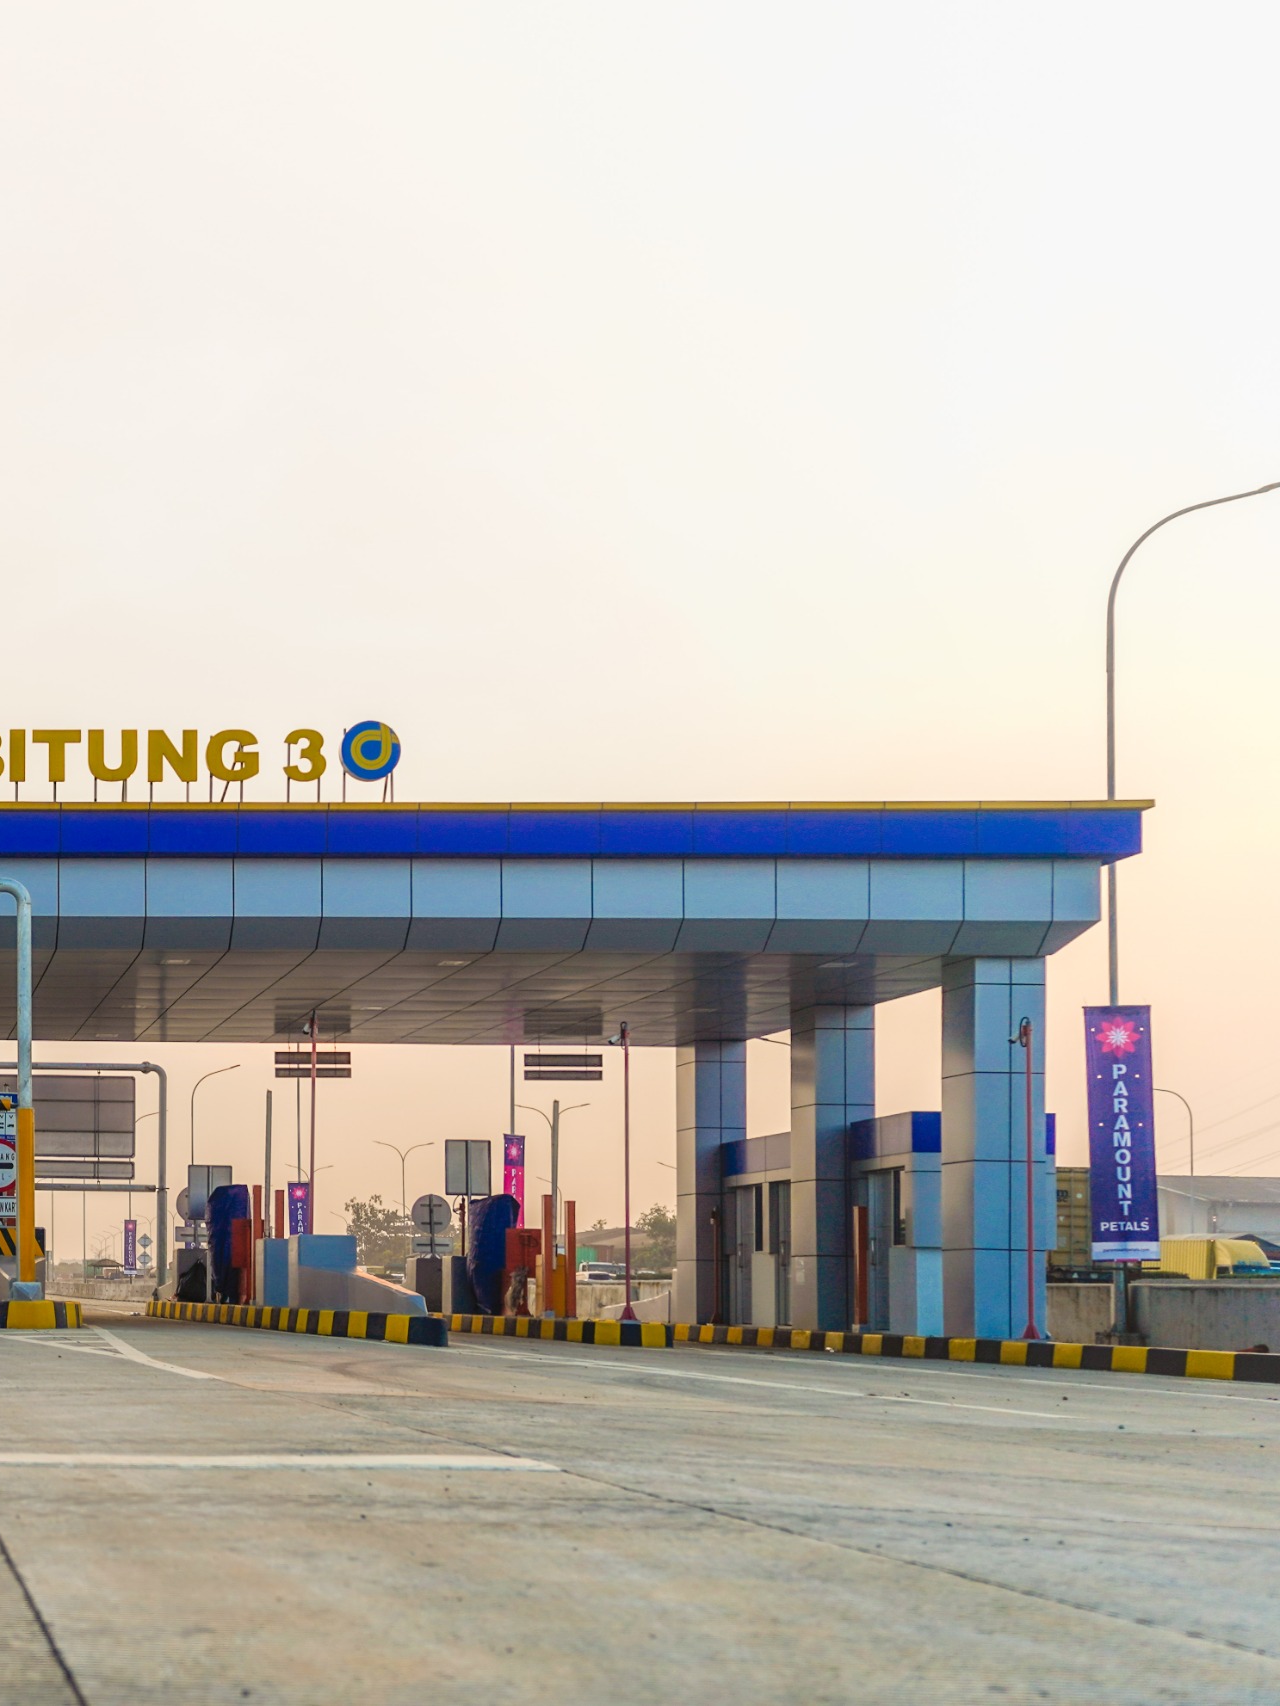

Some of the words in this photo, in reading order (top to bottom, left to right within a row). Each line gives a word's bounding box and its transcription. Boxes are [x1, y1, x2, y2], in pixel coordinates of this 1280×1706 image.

[283, 729, 326, 782] 3
[1112, 1064, 1132, 1216] PARAMOUNT
[4, 1202, 15, 1213] KAR
[1100, 1221, 1150, 1231] PETALS
